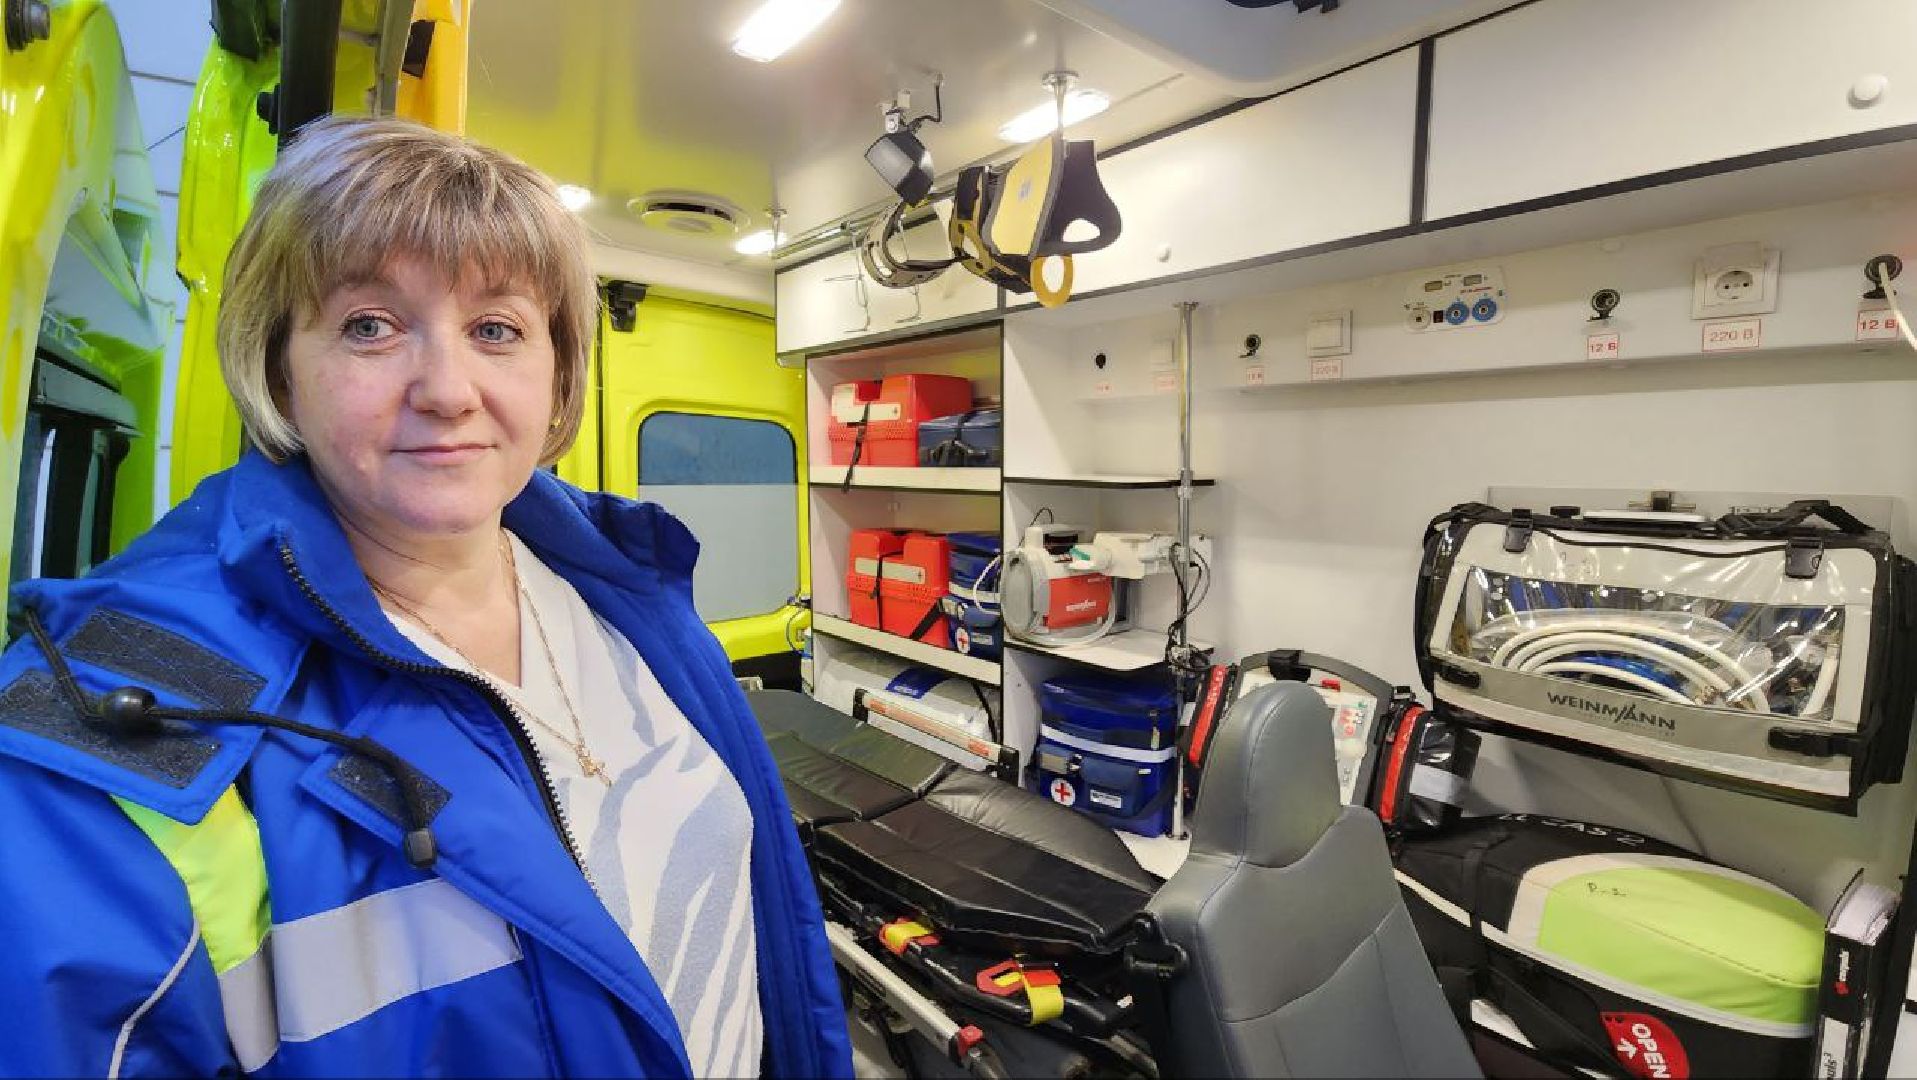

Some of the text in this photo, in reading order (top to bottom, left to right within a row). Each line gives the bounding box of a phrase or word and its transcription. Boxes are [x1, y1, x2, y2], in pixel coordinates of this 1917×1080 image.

[1860, 319, 1879, 330] 12
[1709, 330, 1737, 342] 220
[1591, 343, 1604, 353] 12
[1546, 691, 1676, 731] WEINMANN
[1632, 1023, 1672, 1079] OPEN
